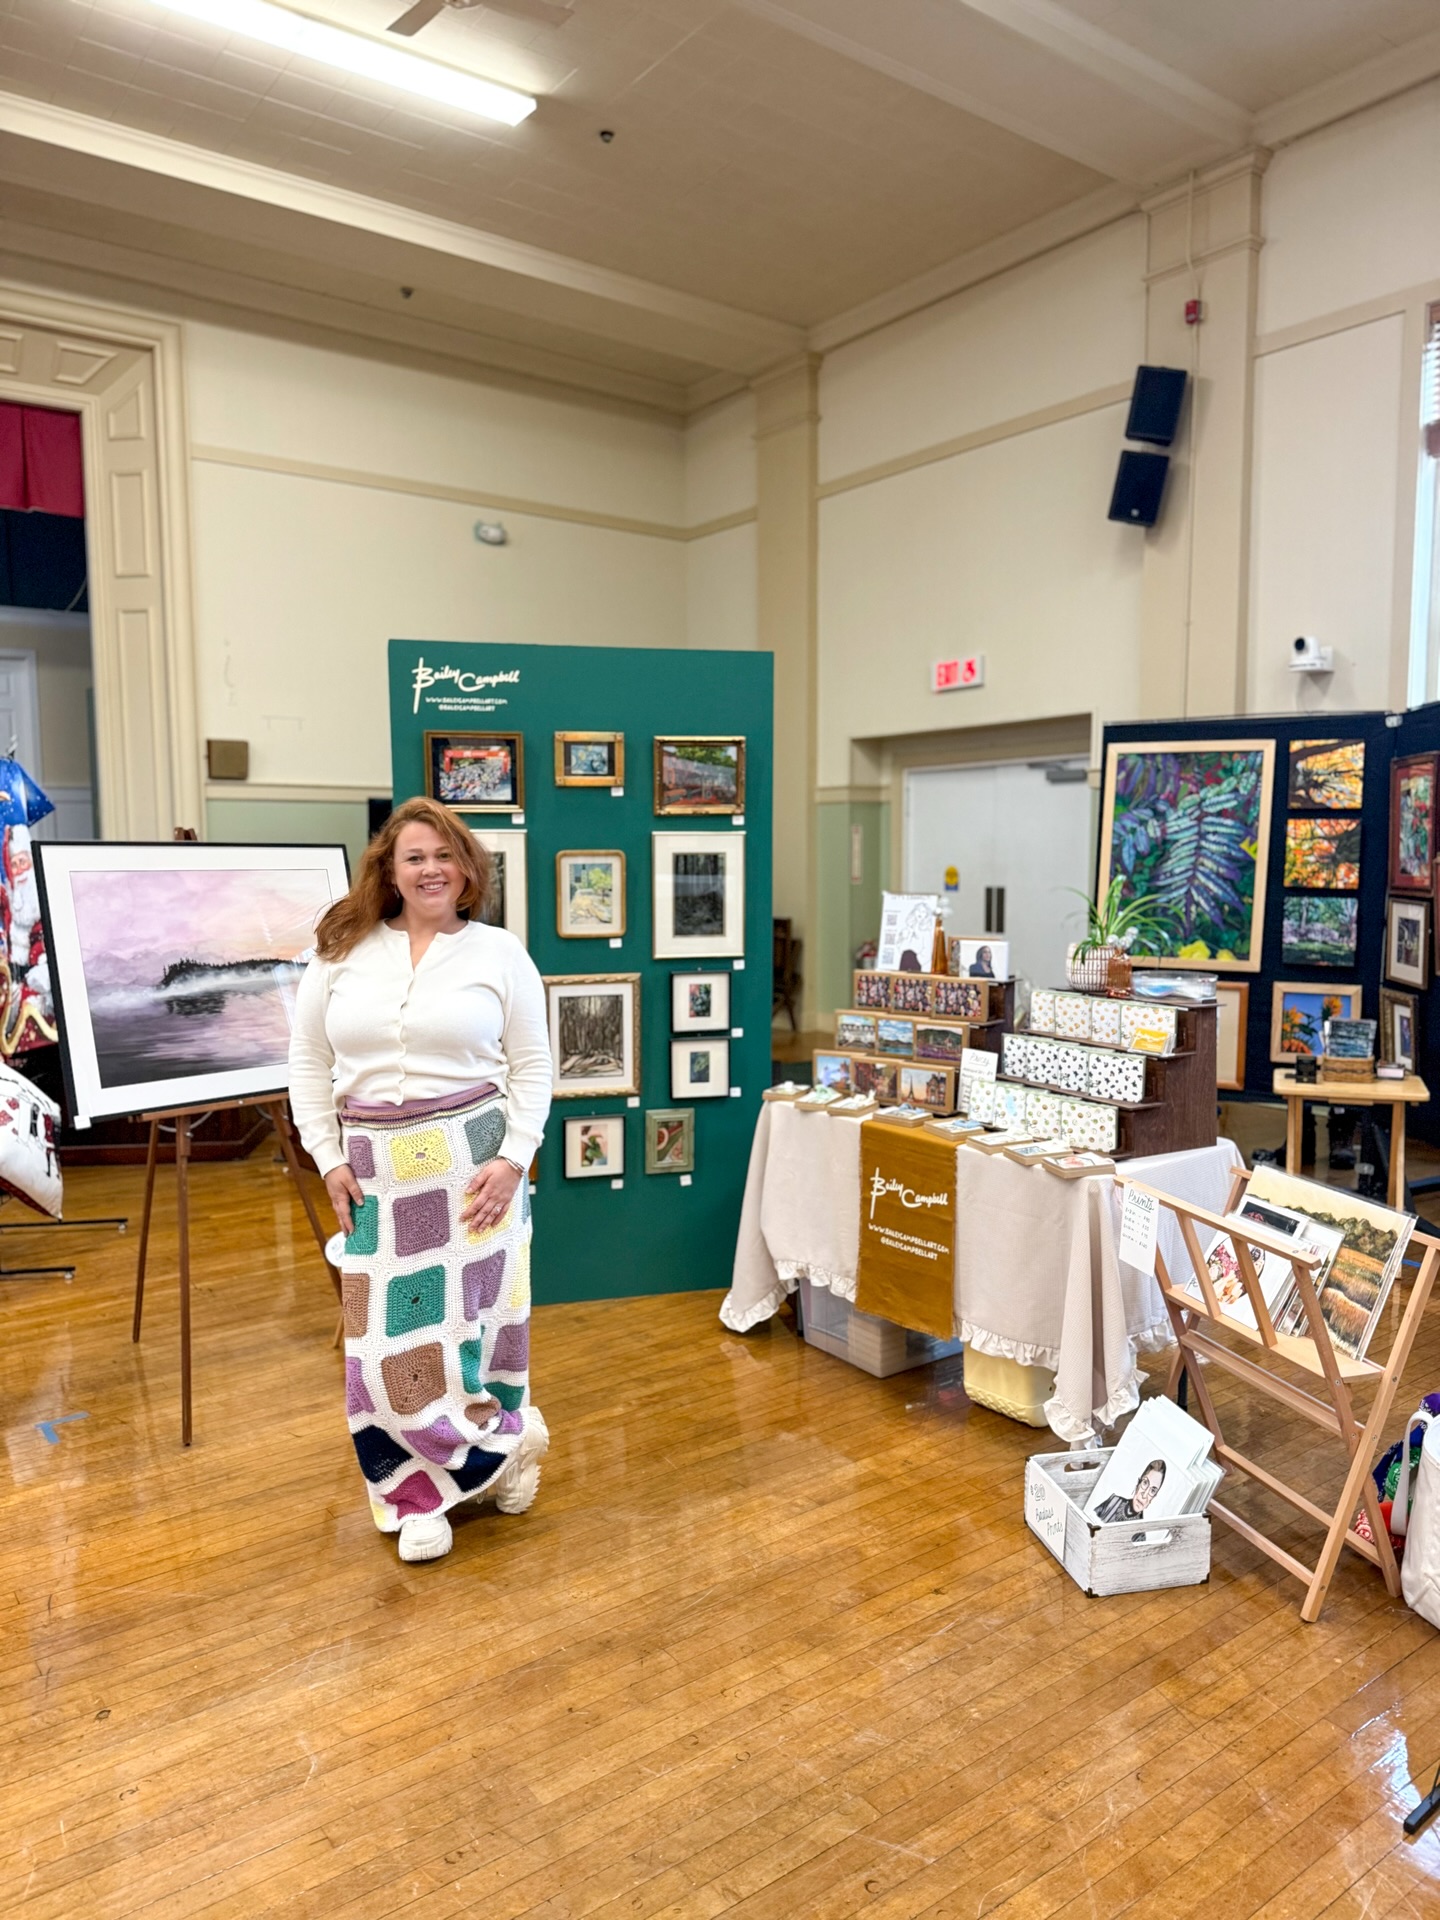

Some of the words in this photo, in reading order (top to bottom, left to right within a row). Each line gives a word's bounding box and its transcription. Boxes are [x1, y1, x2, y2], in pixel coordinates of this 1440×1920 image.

[411, 657, 460, 714] Bailey
[458, 670, 520, 692] Campbell
[870, 1167, 904, 1219] Bailey
[901, 1189, 948, 1208] Campbell
